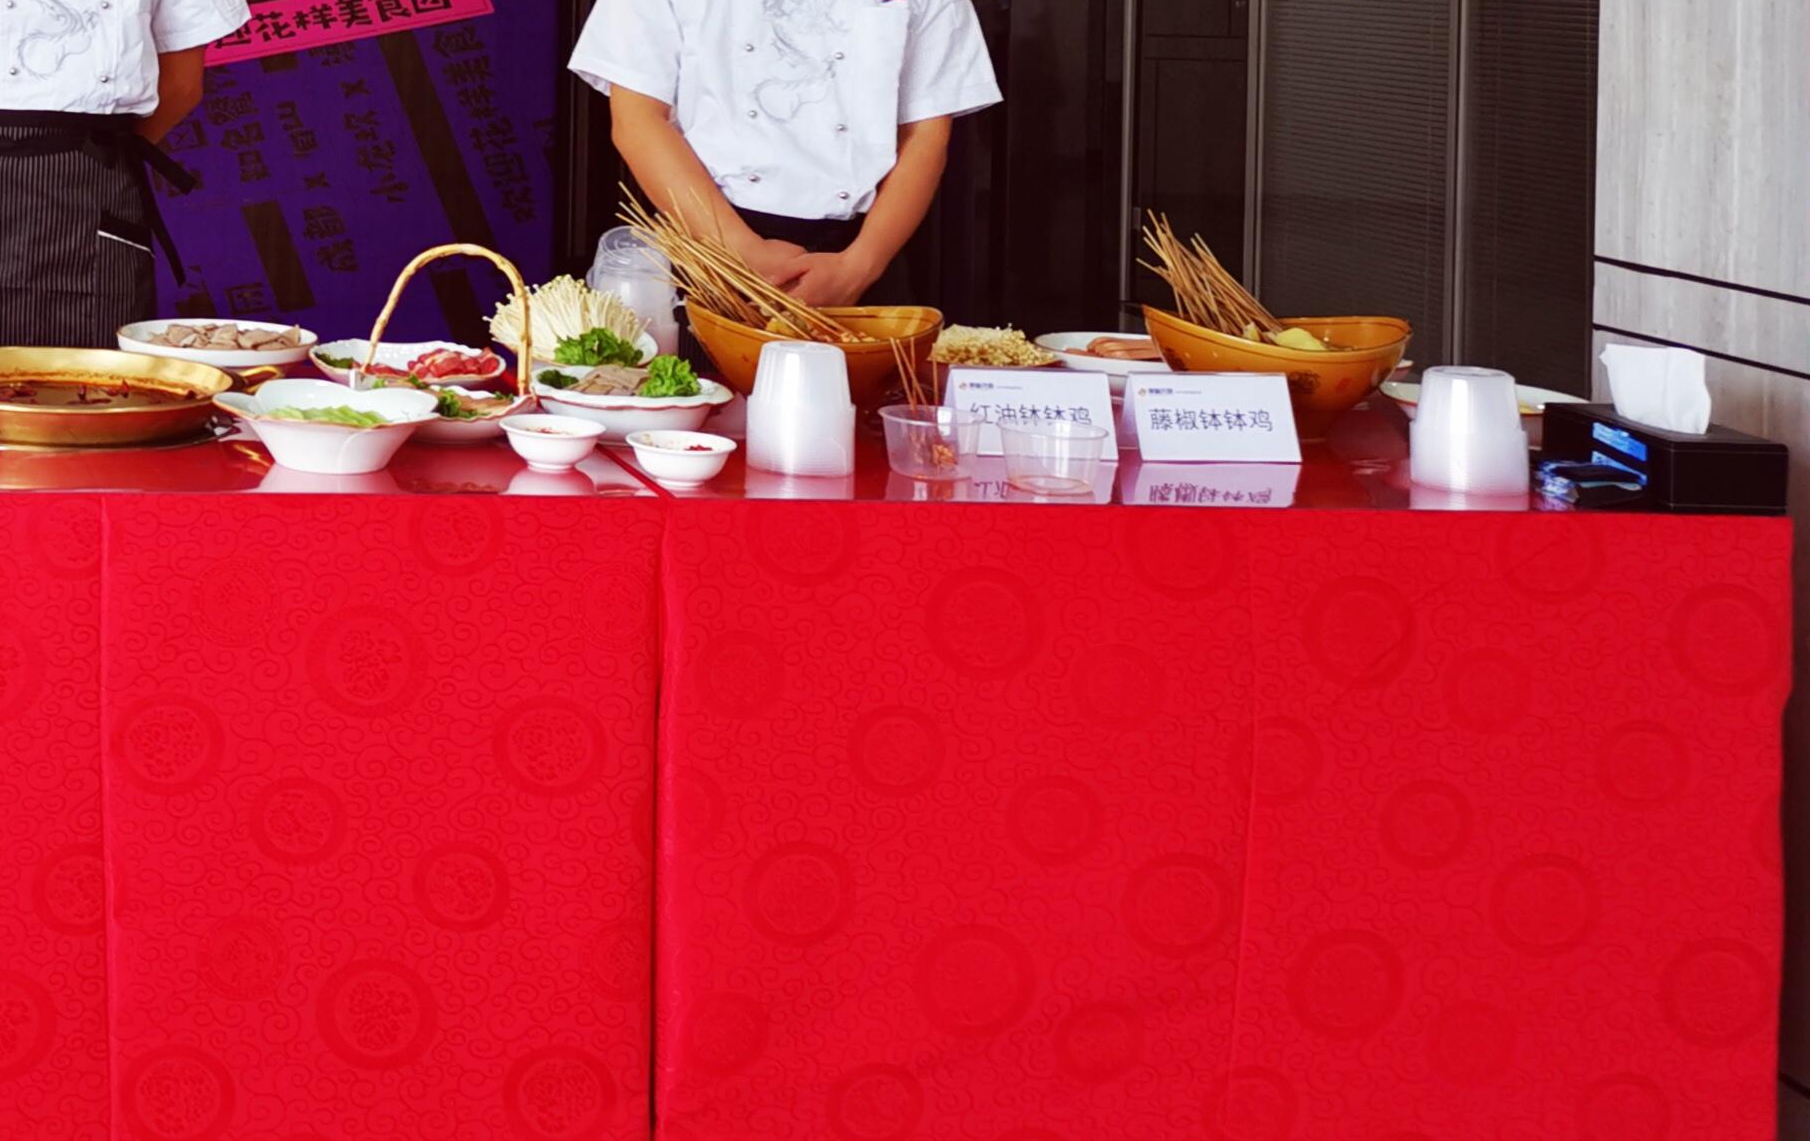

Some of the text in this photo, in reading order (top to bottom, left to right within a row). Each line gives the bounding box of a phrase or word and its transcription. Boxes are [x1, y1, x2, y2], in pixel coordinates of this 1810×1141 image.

[1147, 407, 1274, 432] 藤椒钵钵鸡
